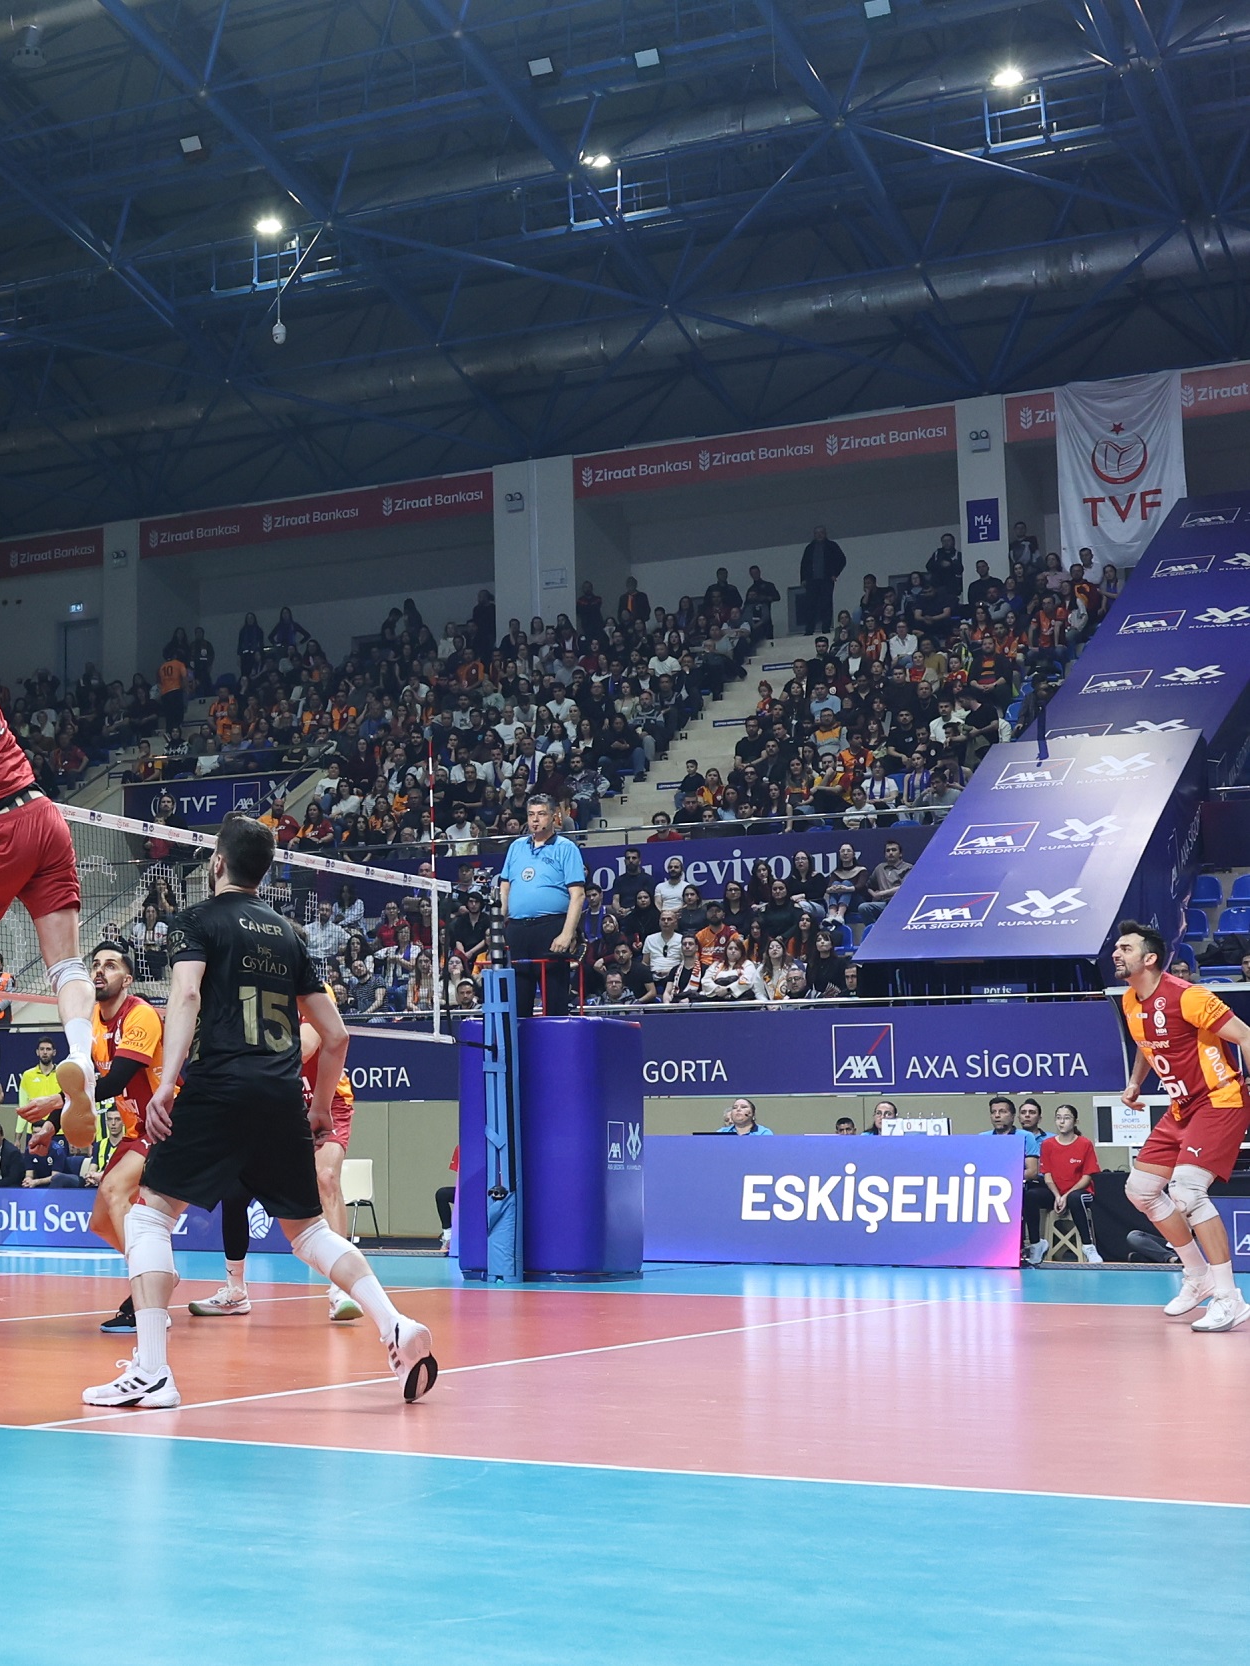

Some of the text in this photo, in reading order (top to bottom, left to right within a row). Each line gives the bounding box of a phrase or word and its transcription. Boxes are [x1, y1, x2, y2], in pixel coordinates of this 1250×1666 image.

[1198, 382, 1250, 400] Ziraat
[841, 426, 946, 450] Ziraat Bankası
[713, 444, 813, 466] Ziraat Bankası
[594, 460, 692, 482] Ziraat Bankası
[394, 490, 483, 511] Ziraat Bankası
[1082, 488, 1162, 527] TVF
[274, 507, 359, 528] Ziraat Bankası
[975, 514, 992, 526] M4
[160, 523, 240, 544] Ziraat Bankası
[20, 550, 52, 564] Ziraat
[997, 770, 1052, 782] AXA
[180, 794, 217, 814] TVF
[957, 835, 1014, 847] AXA
[913, 907, 972, 921] AXA
[998, 919, 1078, 927] KUPAVOLEY
[239, 917, 283, 936] CANER
[239, 986, 293, 1052] 15
[643, 1060, 728, 1083] GORTA
[836, 1050, 1089, 1079] AXA AXA SİGORTA
[887, 1123, 896, 1135] 7
[906, 1122, 912, 1130] 0
[933, 1124, 942, 1136] 9
[741, 1162, 1012, 1234] ESKİŞEHİR
